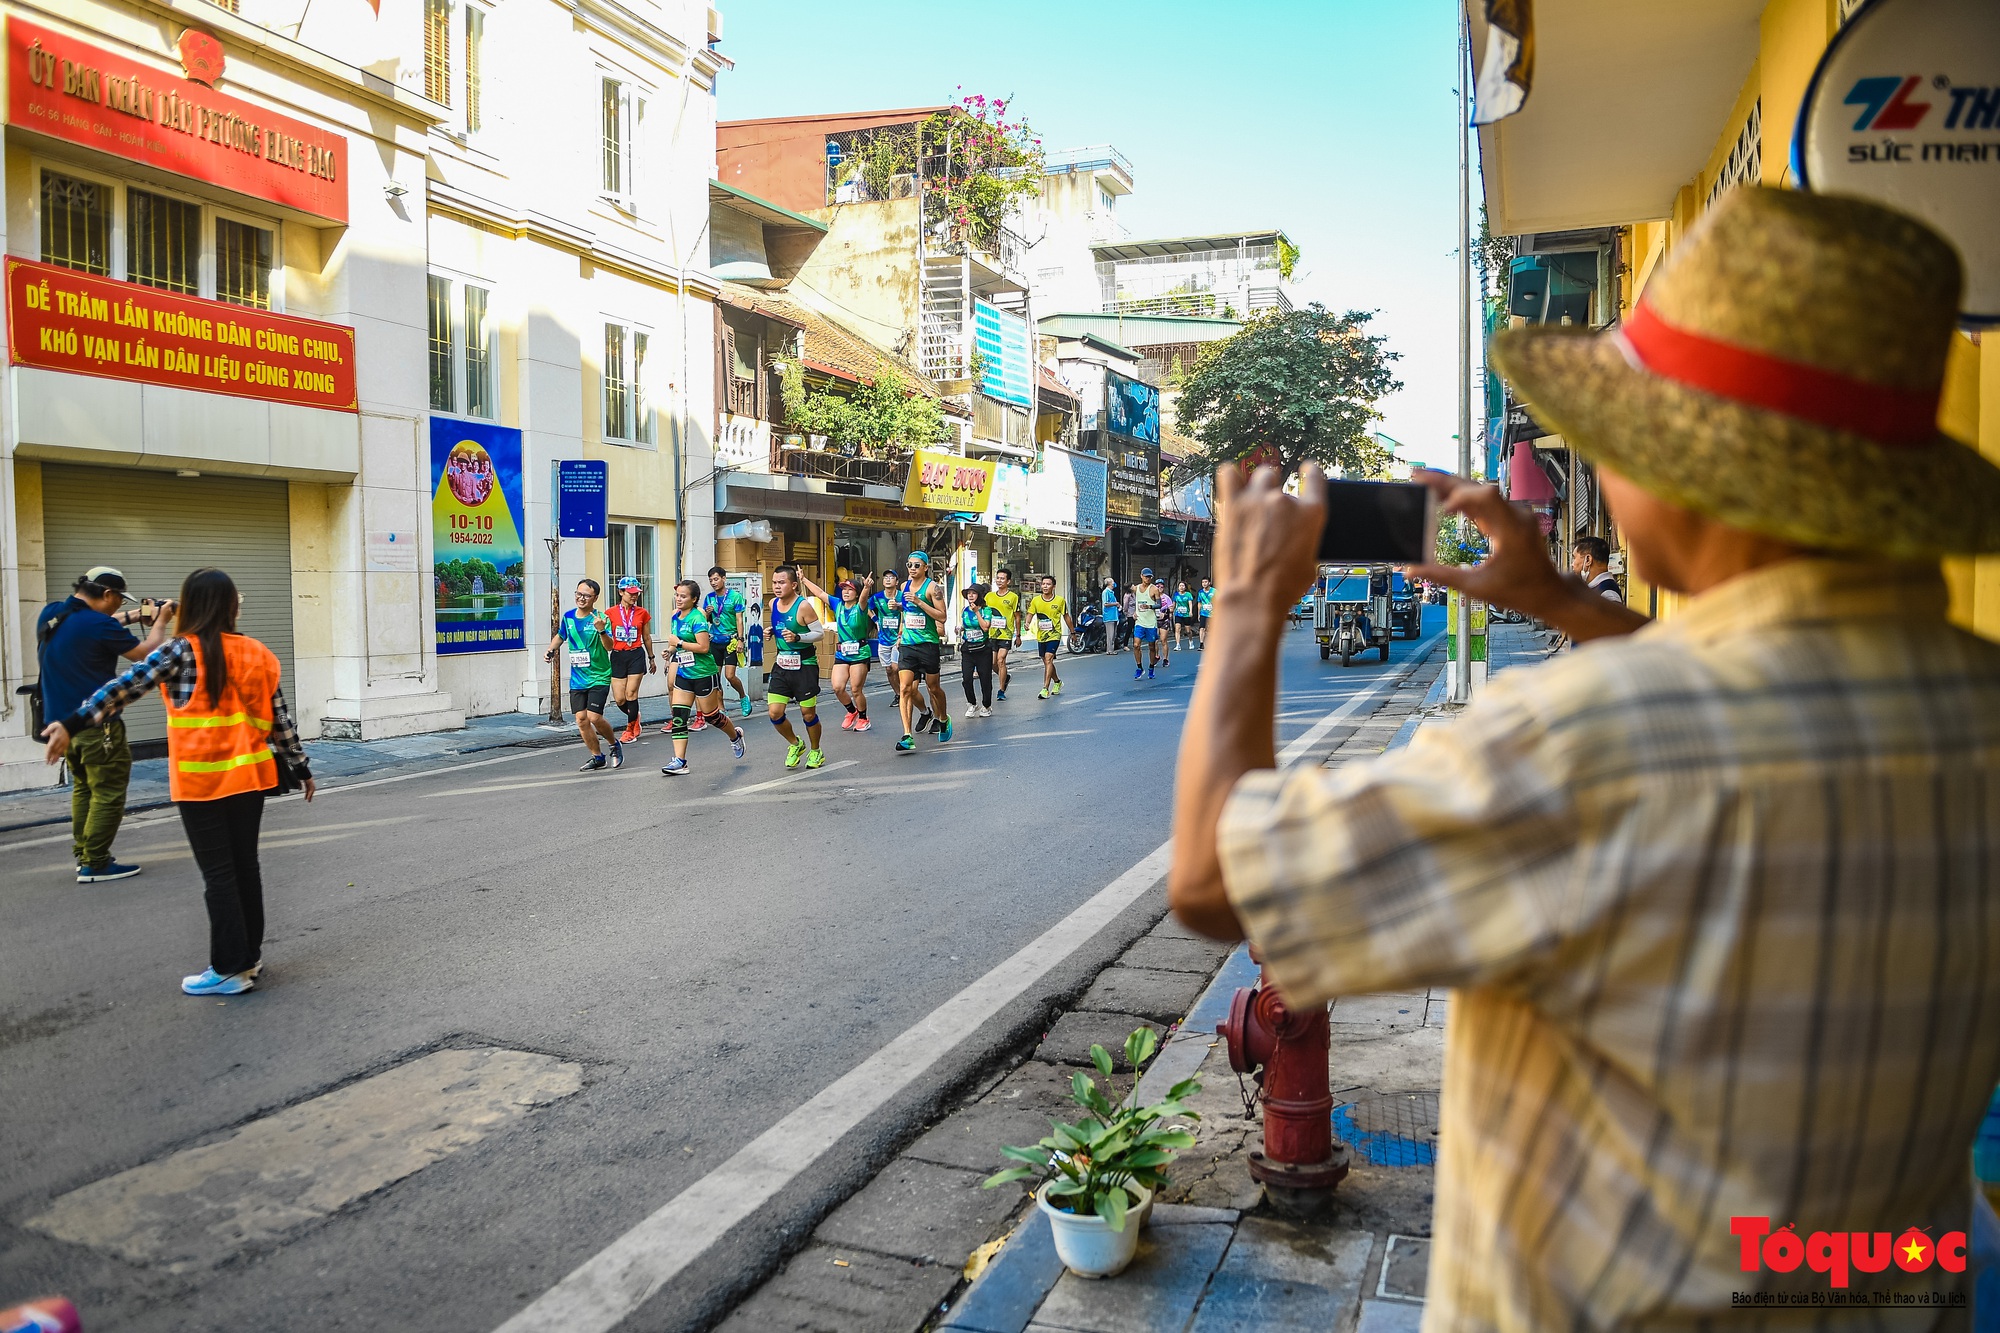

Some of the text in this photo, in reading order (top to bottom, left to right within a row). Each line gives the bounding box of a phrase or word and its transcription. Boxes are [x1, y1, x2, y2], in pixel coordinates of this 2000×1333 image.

[28, 38, 57, 88] ỦY
[62, 58, 100, 104] BAN
[105, 75, 153, 122] NHÂN
[158, 90, 194, 135] DÂN
[48, 109, 59, 121] 56
[26, 278, 343, 365] DỄ TRĂM LẦN KHÔNG DÂN CŨNG CHỊU,
[40, 327, 335, 394] KHÓ VẠN LẦN DÂN LIỆU CŨNG XONG
[449, 514, 492, 530] 10-10
[450, 532, 492, 544] 1954-2022
[752, 587, 760, 598] 5K
